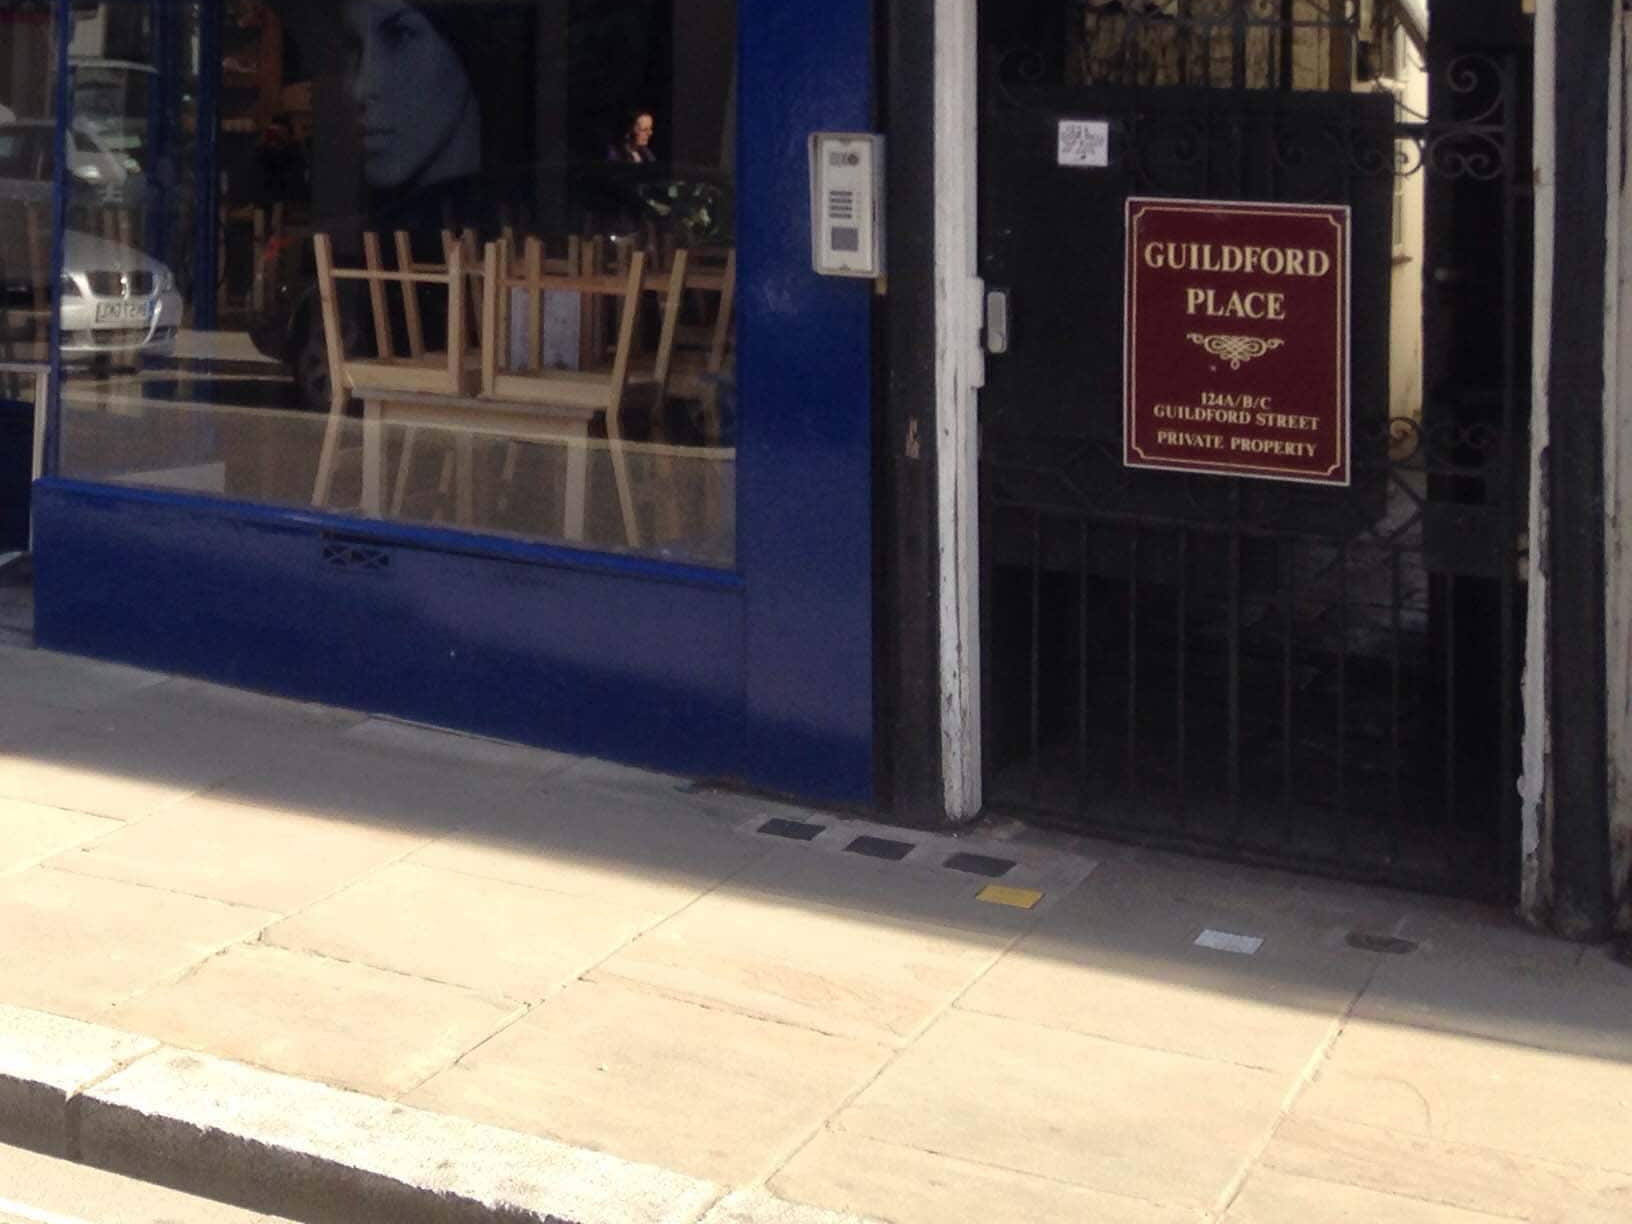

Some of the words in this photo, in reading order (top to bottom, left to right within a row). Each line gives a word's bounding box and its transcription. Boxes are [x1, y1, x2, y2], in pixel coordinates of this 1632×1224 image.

[1144, 242, 1330, 277] GUILDFORD
[1186, 287, 1286, 320] PLACE
[1200, 391, 1272, 410] 124A/B/C
[1153, 404, 1252, 425] GUILDFORD
[1255, 413, 1321, 431] STREET
[1156, 430, 1225, 449] PRIVATE
[1230, 436, 1317, 457] PROPERTY
